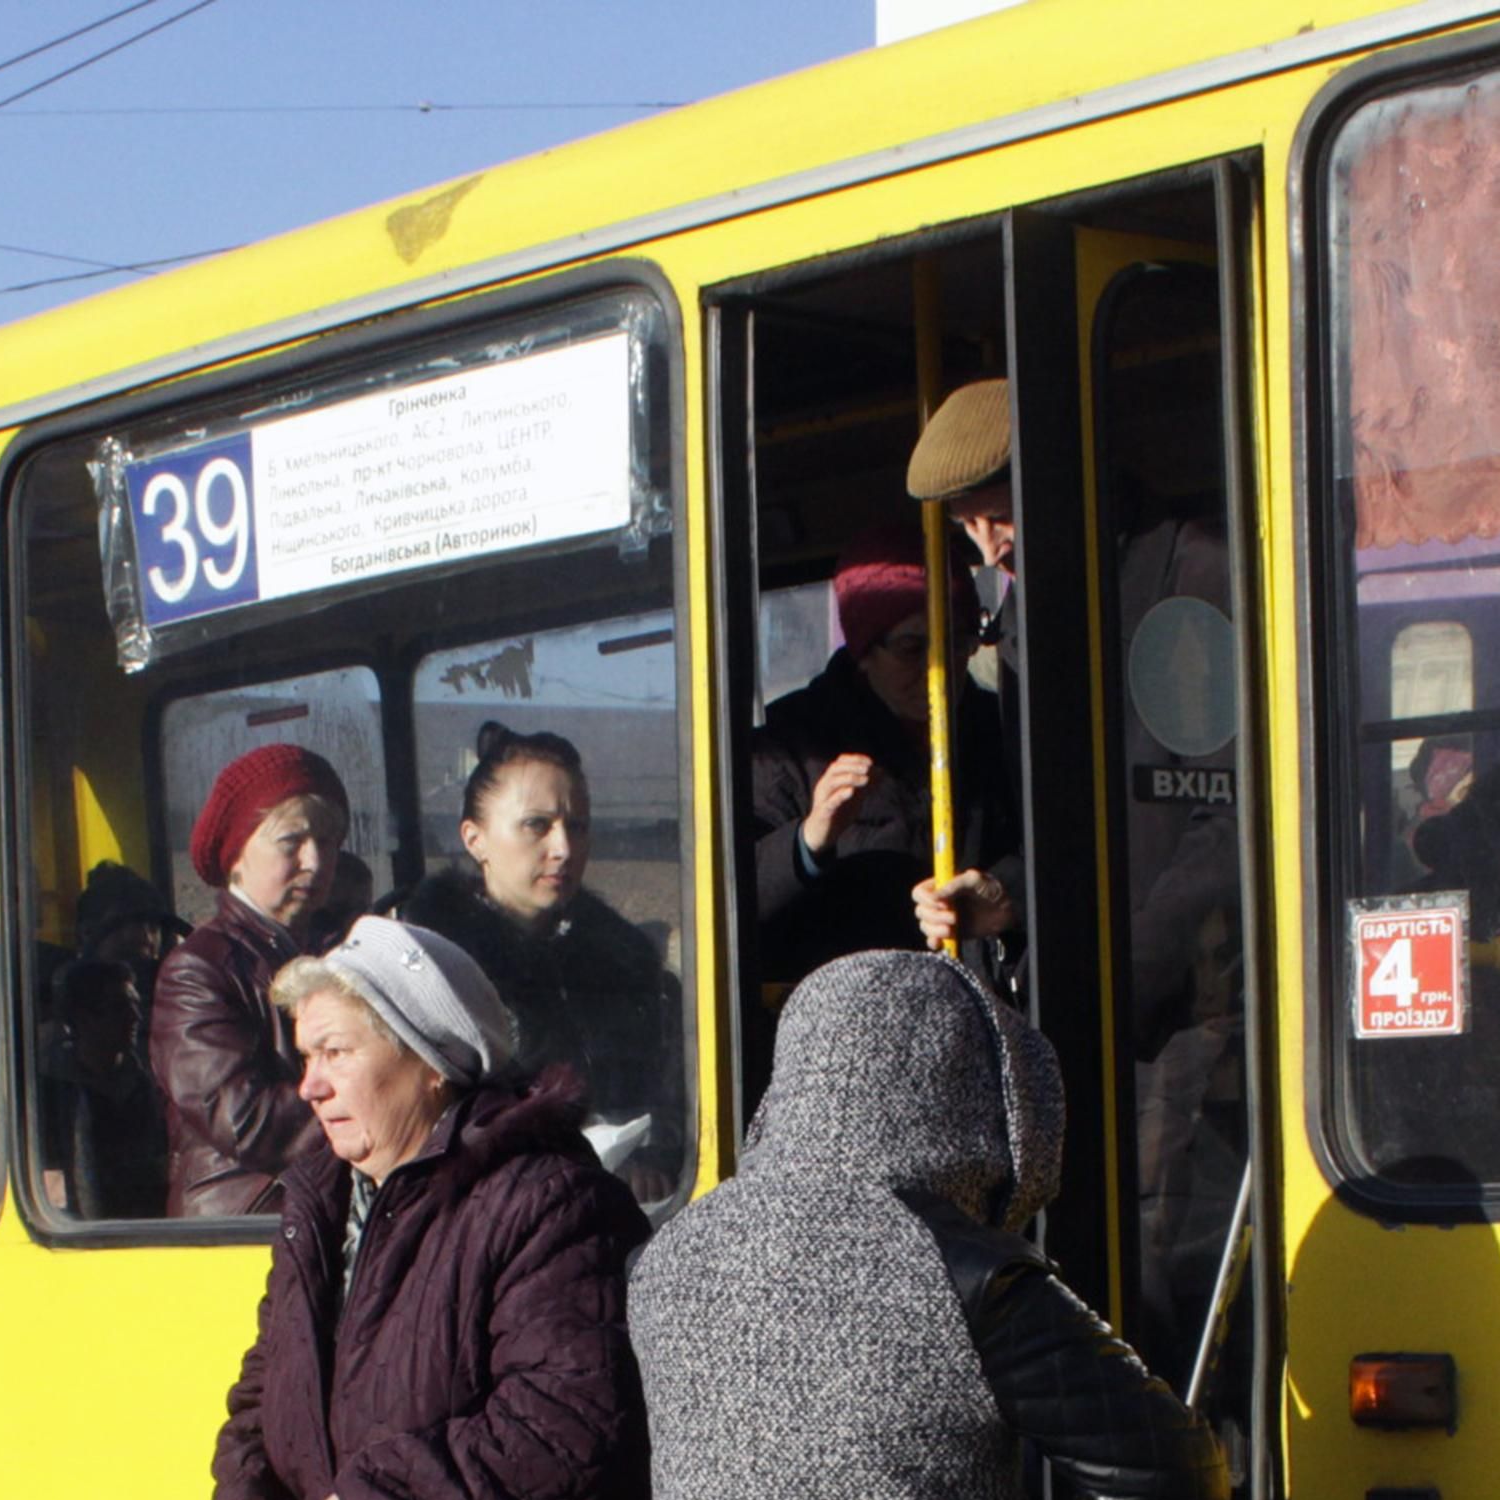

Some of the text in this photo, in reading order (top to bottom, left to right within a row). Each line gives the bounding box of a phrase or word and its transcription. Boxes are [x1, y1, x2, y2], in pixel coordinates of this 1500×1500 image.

[388, 385, 467, 420] Грінченка
[351, 460, 392, 485] пр-кт
[372, 499, 466, 536] Кривчицька
[470, 486, 528, 514] дорога
[141, 457, 249, 604] 39
[330, 512, 538, 575] Богданівська (Авторинок)
[1152, 767, 1233, 803] ВХІД
[1363, 919, 1452, 939] ВАРТІСТЬ
[1369, 938, 1453, 1008] 4 грн.
[1370, 1007, 1448, 1028] ПРОЇЗДУ
